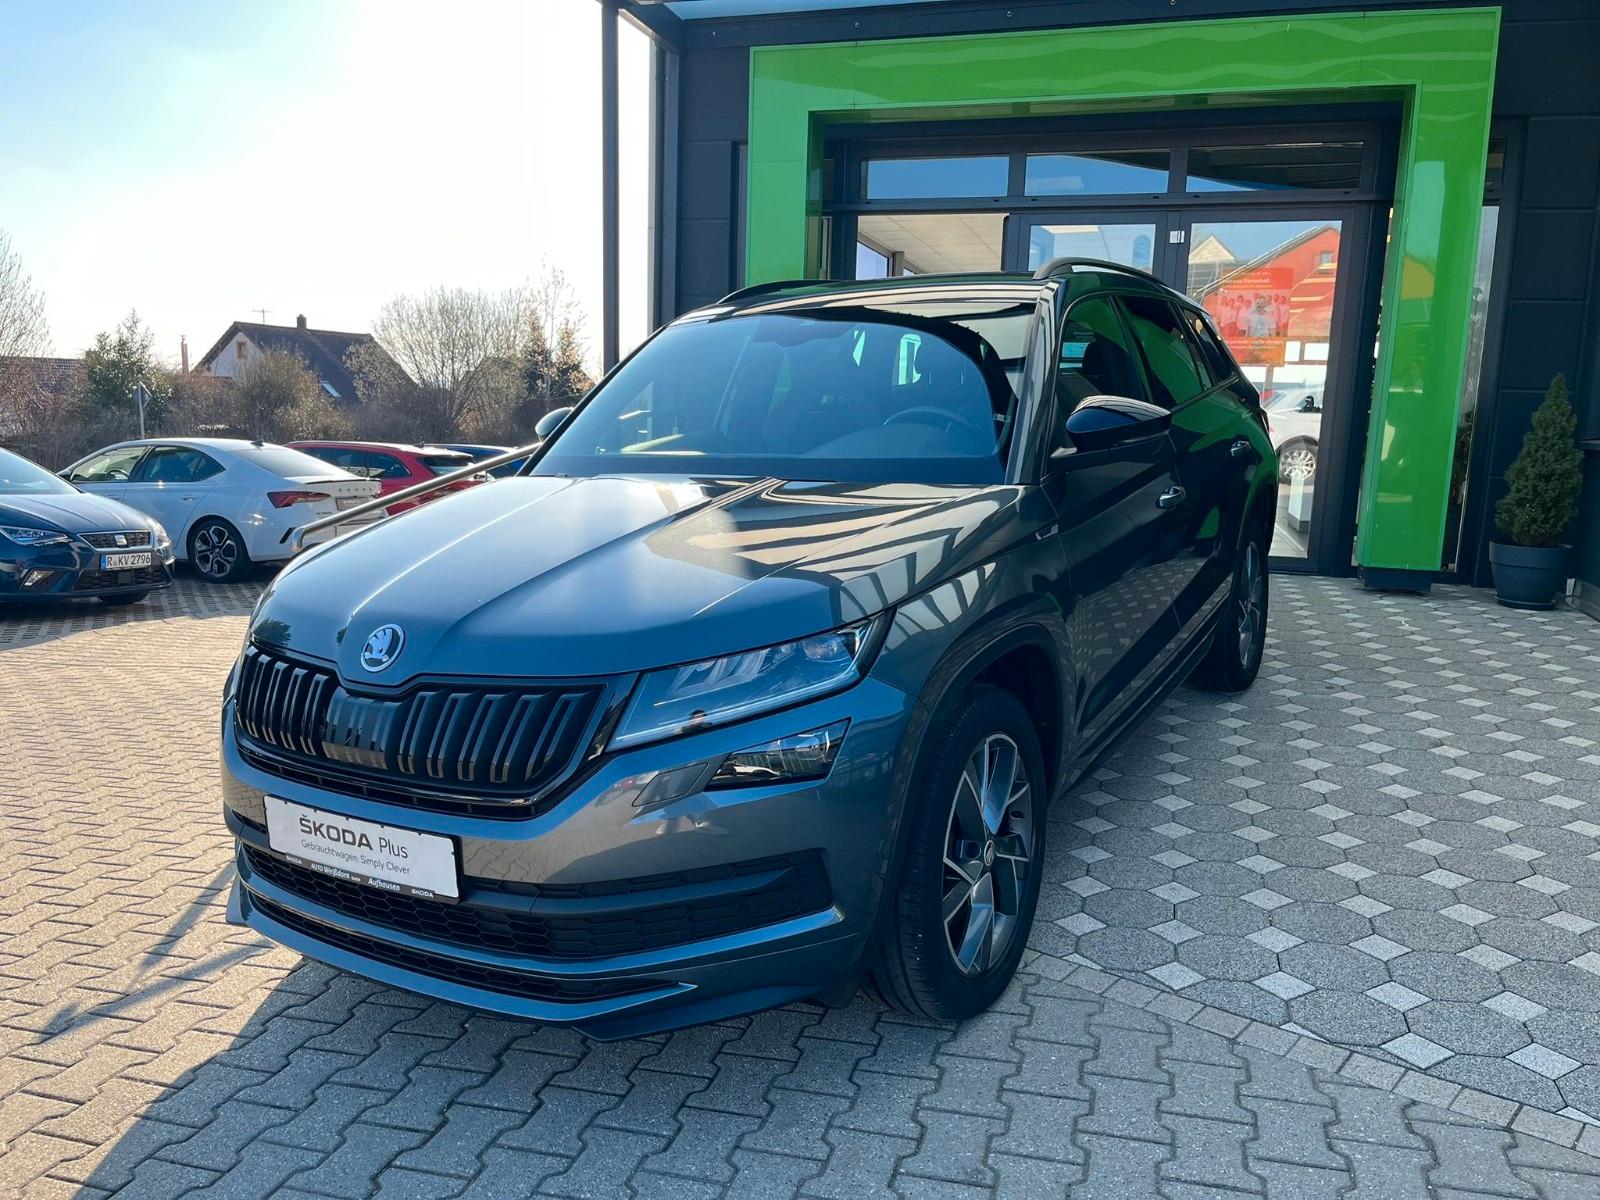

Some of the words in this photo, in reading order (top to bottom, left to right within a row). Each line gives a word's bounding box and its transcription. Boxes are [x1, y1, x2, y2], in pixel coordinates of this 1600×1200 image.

[107, 557, 113, 567] R
[118, 555, 130, 566] KV
[131, 554, 150, 565] 2796
[300, 815, 373, 850] ŠKODA
[379, 837, 408, 859] Plus
[360, 854, 385, 871] Simply
[386, 861, 410, 875] Clever
[368, 878, 401, 892] Aufhausen
